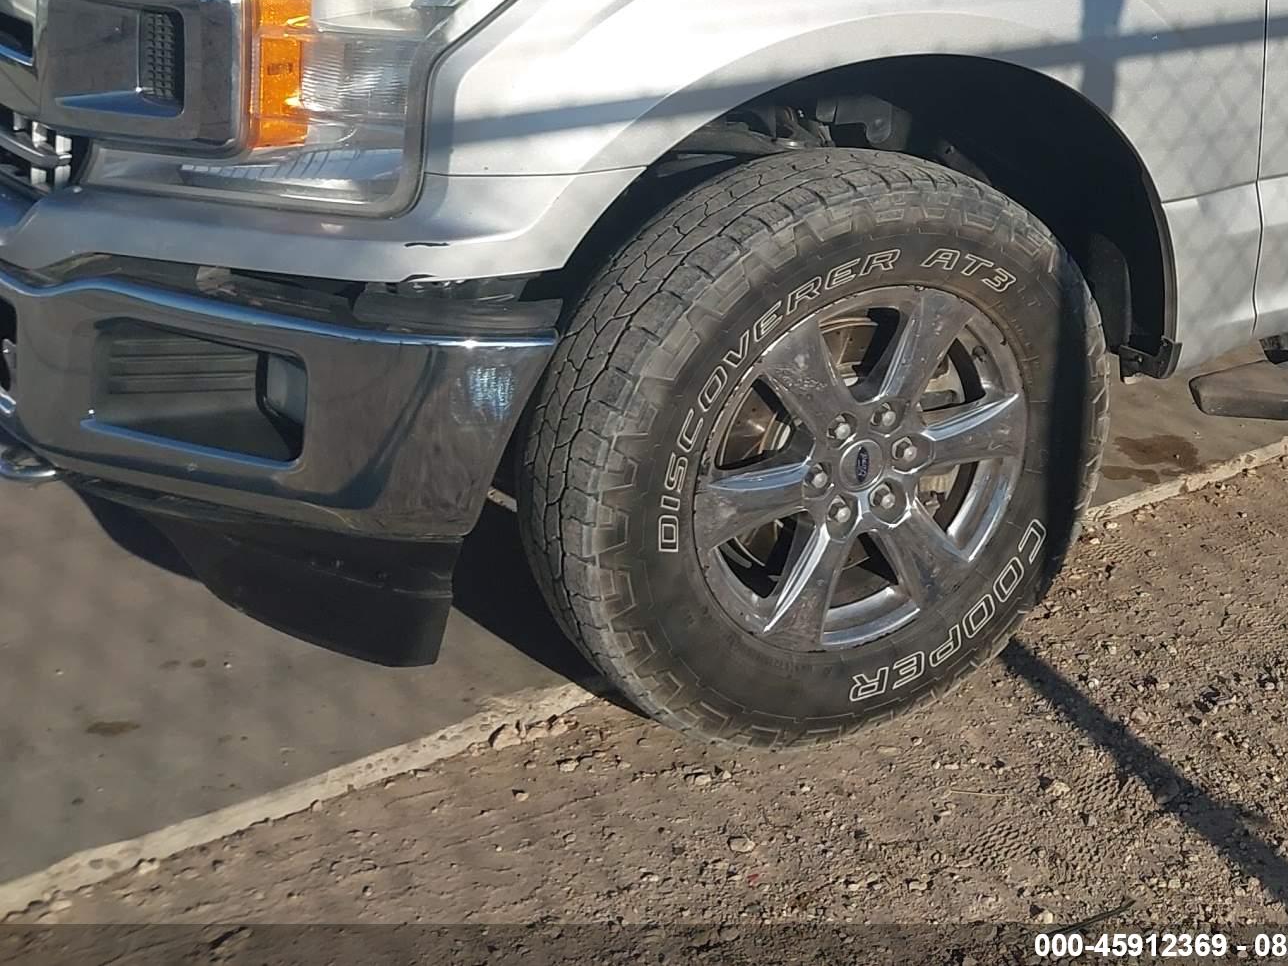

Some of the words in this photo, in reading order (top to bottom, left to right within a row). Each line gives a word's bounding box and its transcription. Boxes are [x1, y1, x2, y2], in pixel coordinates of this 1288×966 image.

[658, 247, 901, 554] DISCOVERER
[920, 247, 1018, 293] AT3
[849, 519, 1048, 703] COOPER
